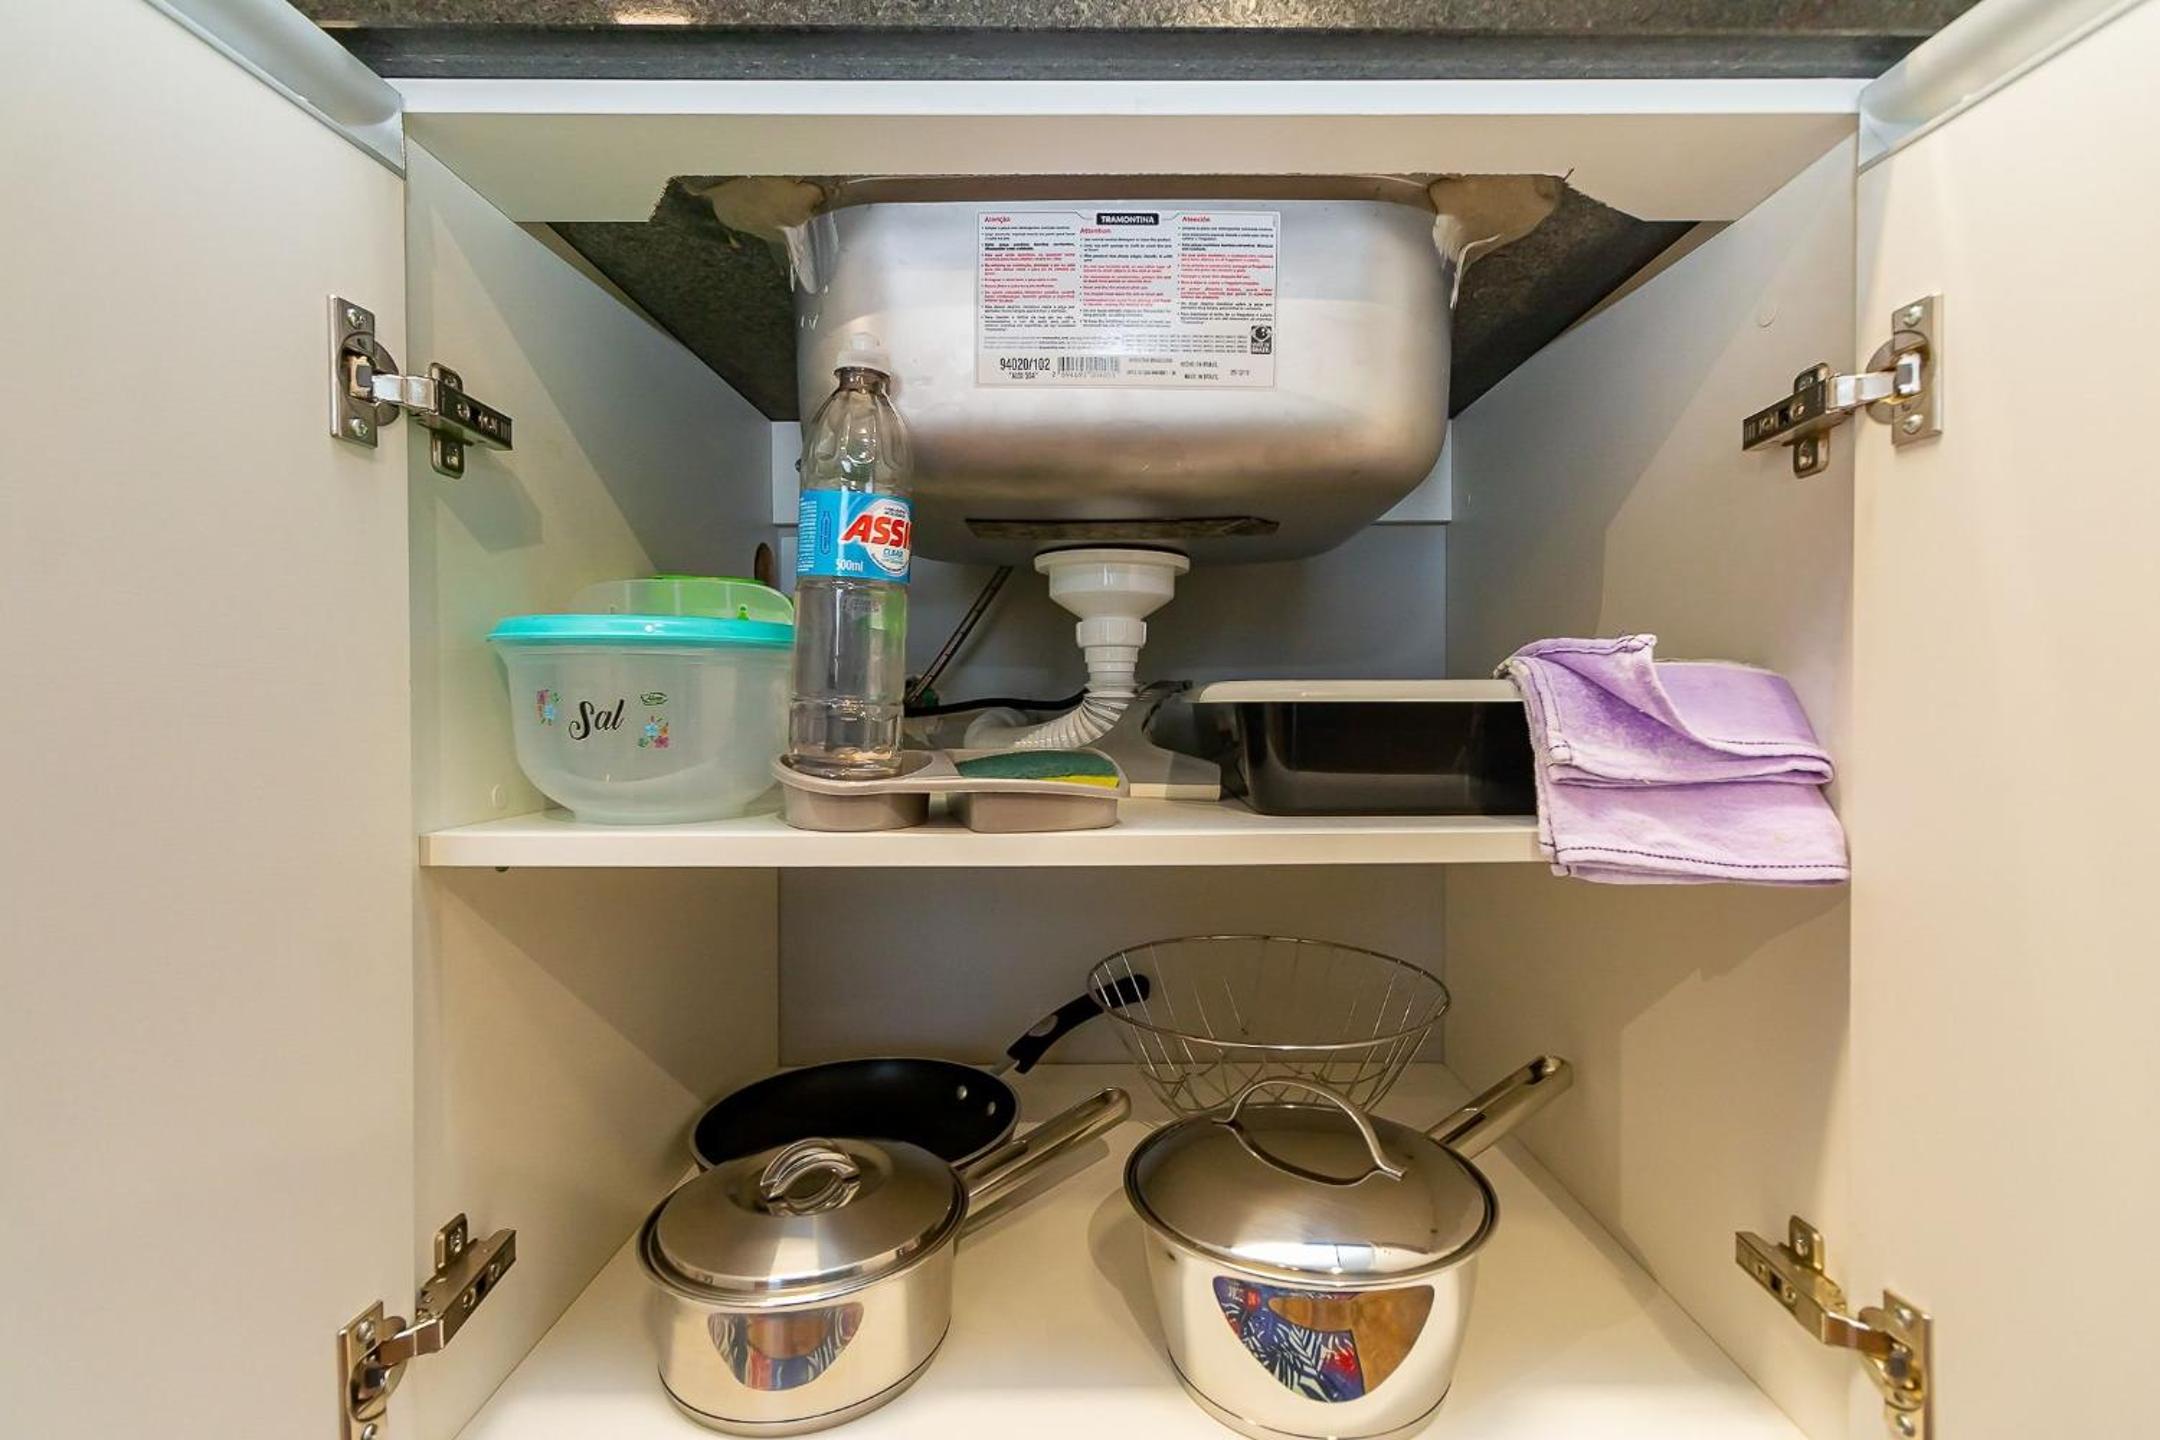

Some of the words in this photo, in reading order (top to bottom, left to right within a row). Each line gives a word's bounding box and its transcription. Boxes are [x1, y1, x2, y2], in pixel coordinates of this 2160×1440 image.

[1100, 215, 1155, 224] TRAMONTINA
[999, 357, 1051, 371] 94020/102
[841, 514, 912, 549] ASSI
[835, 559, 864, 573] 500ml
[568, 698, 625, 741] Sal
